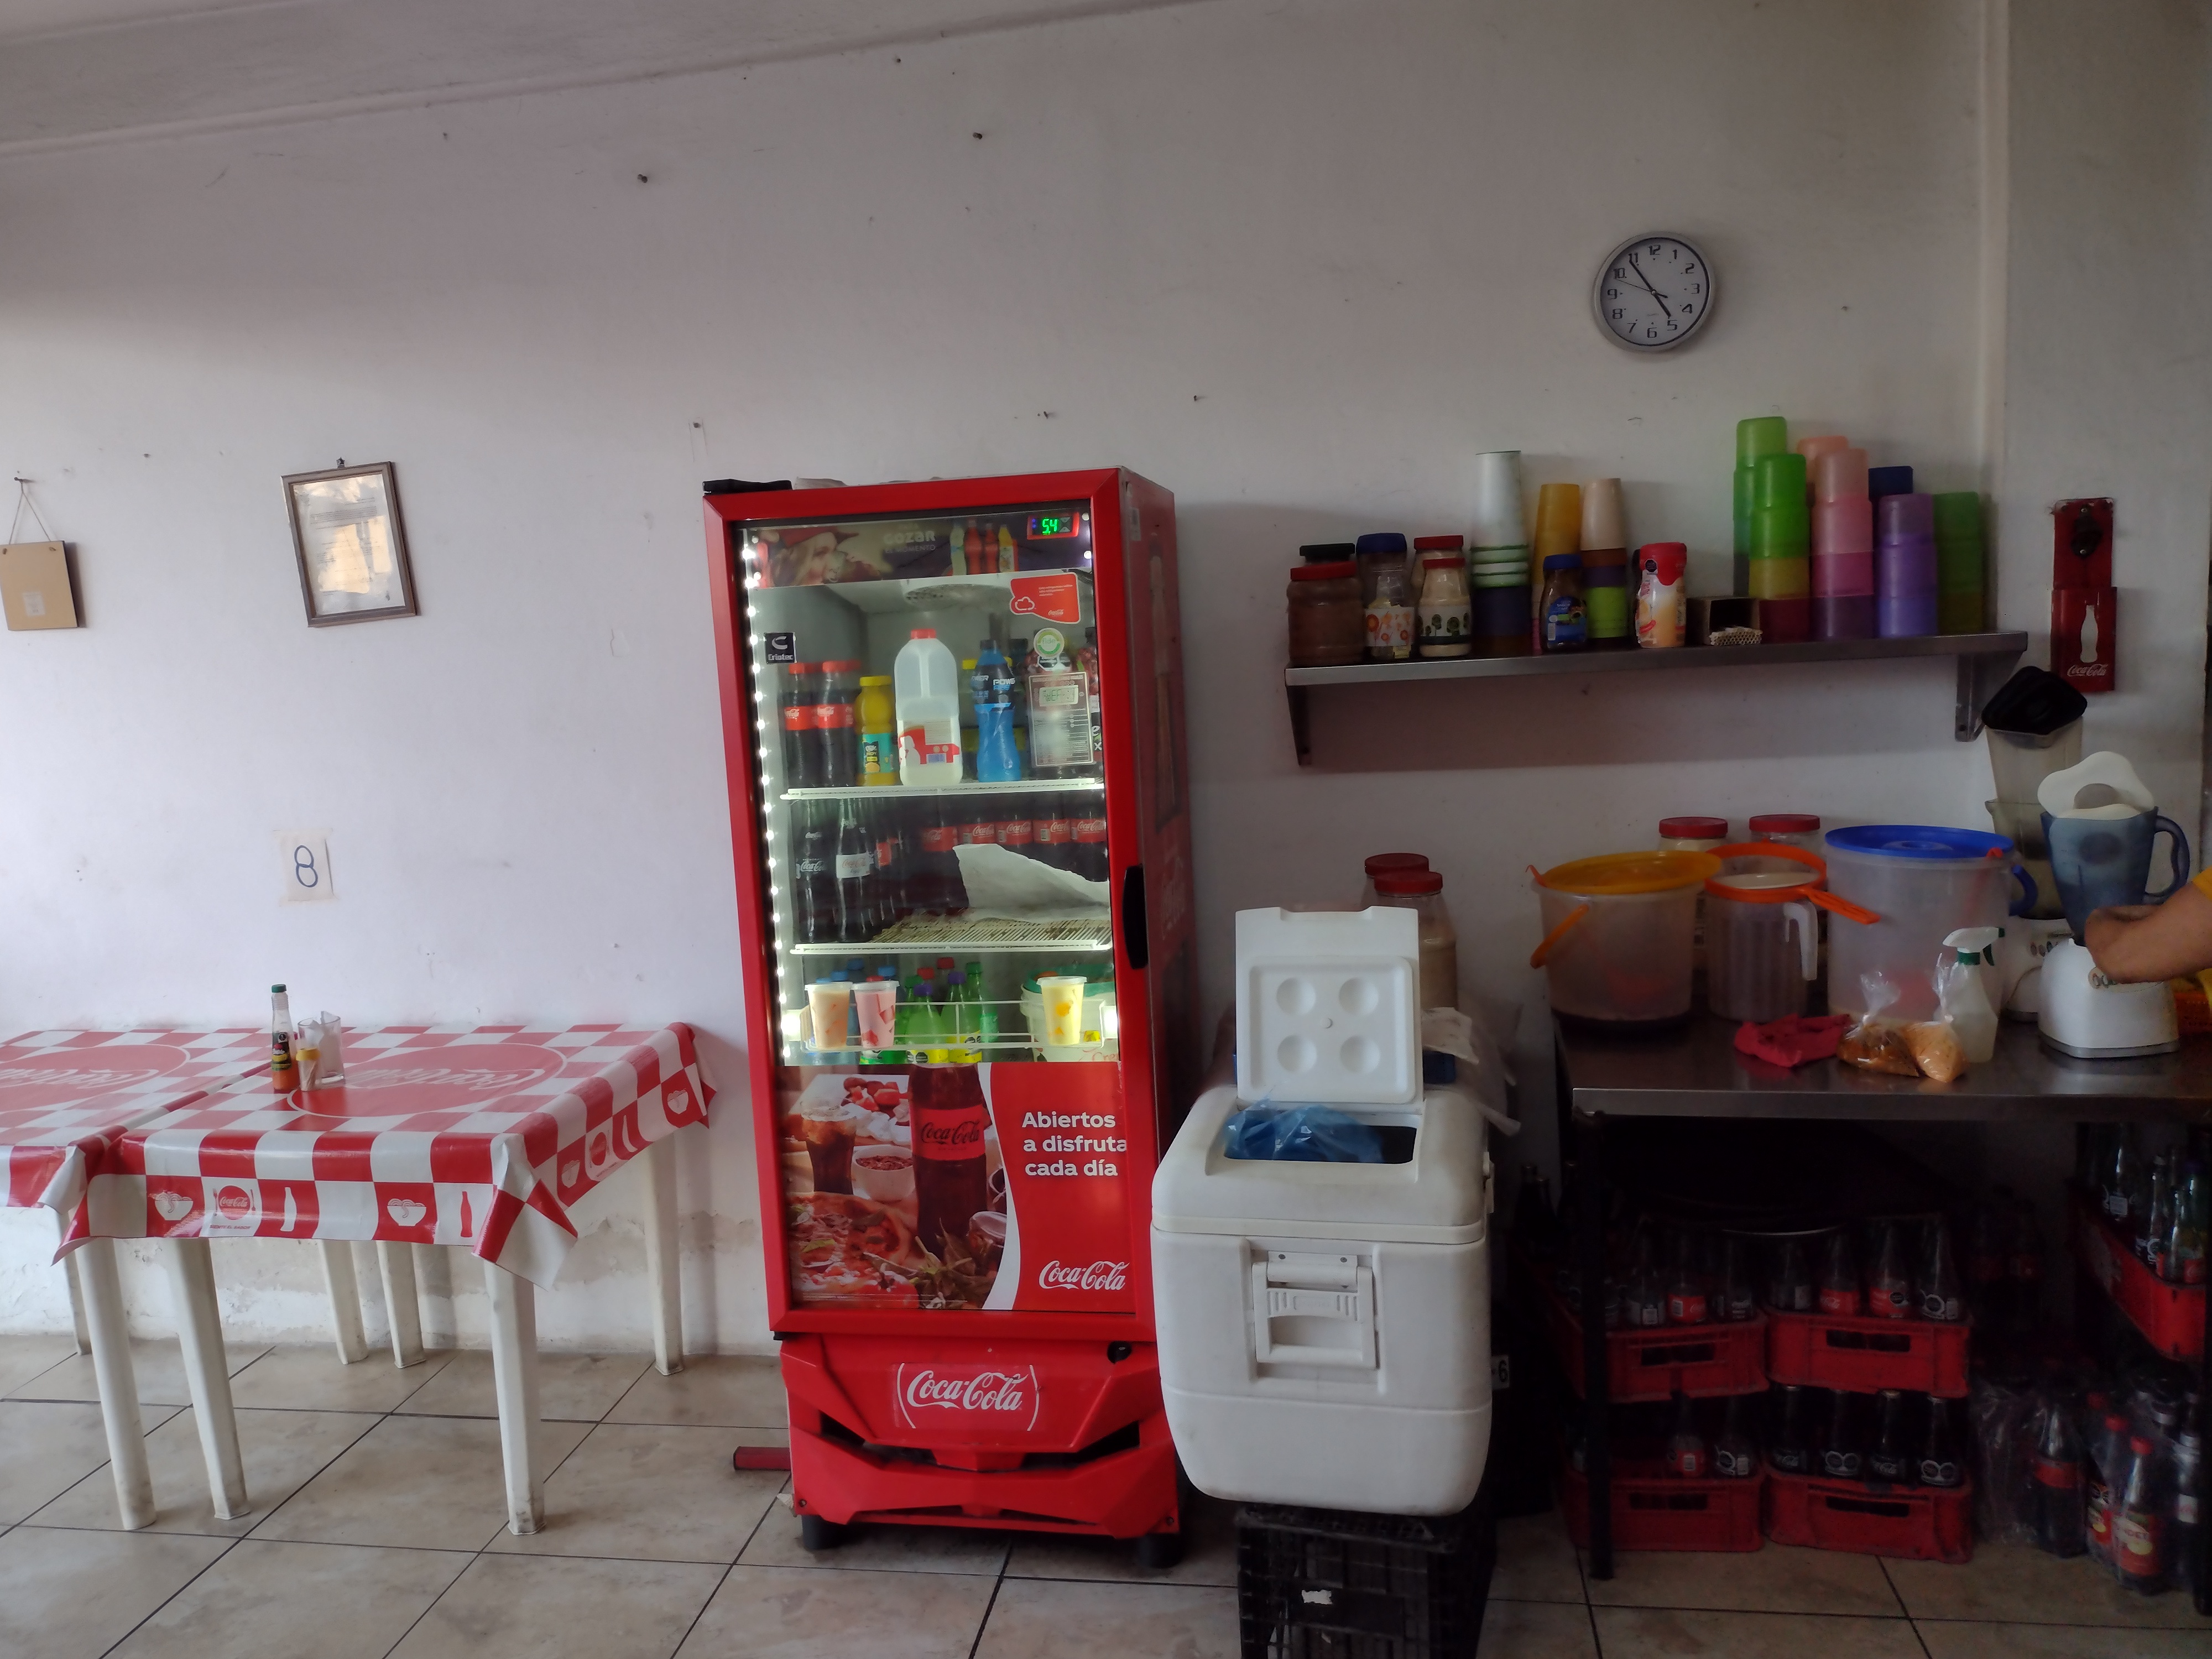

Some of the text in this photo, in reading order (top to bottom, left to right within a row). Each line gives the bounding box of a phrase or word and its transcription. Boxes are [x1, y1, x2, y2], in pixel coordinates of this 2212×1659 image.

[1648, 244, 1661, 255] 12
[1673, 249, 1677, 259] 1
[1628, 253, 1639, 263] 11
[1613, 268, 1626, 279] 10
[1685, 263, 1694, 274] 2
[1607, 289, 1618, 299] 9
[1691, 283, 1700, 294] 3
[1612, 308, 1623, 319] 8
[1682, 304, 1692, 314] 4
[1627, 322, 1637, 333] 7
[1667, 320, 1677, 331] 5
[1647, 327, 1657, 338] 6
[2067, 663, 2109, 677] Coca-Cola
[294, 845, 318, 888] 8
[1022, 1111, 1116, 1128] Abiertos
[921, 1119, 980, 1145] Coca-Cola
[1023, 1139, 1037, 1152] a
[1025, 1159, 1118, 1176] cada día
[219, 1196, 248, 1208] Coca-Cola
[1039, 1260, 1130, 1290] Coca-Cola
[907, 1370, 1029, 1411] Coca-Cola
